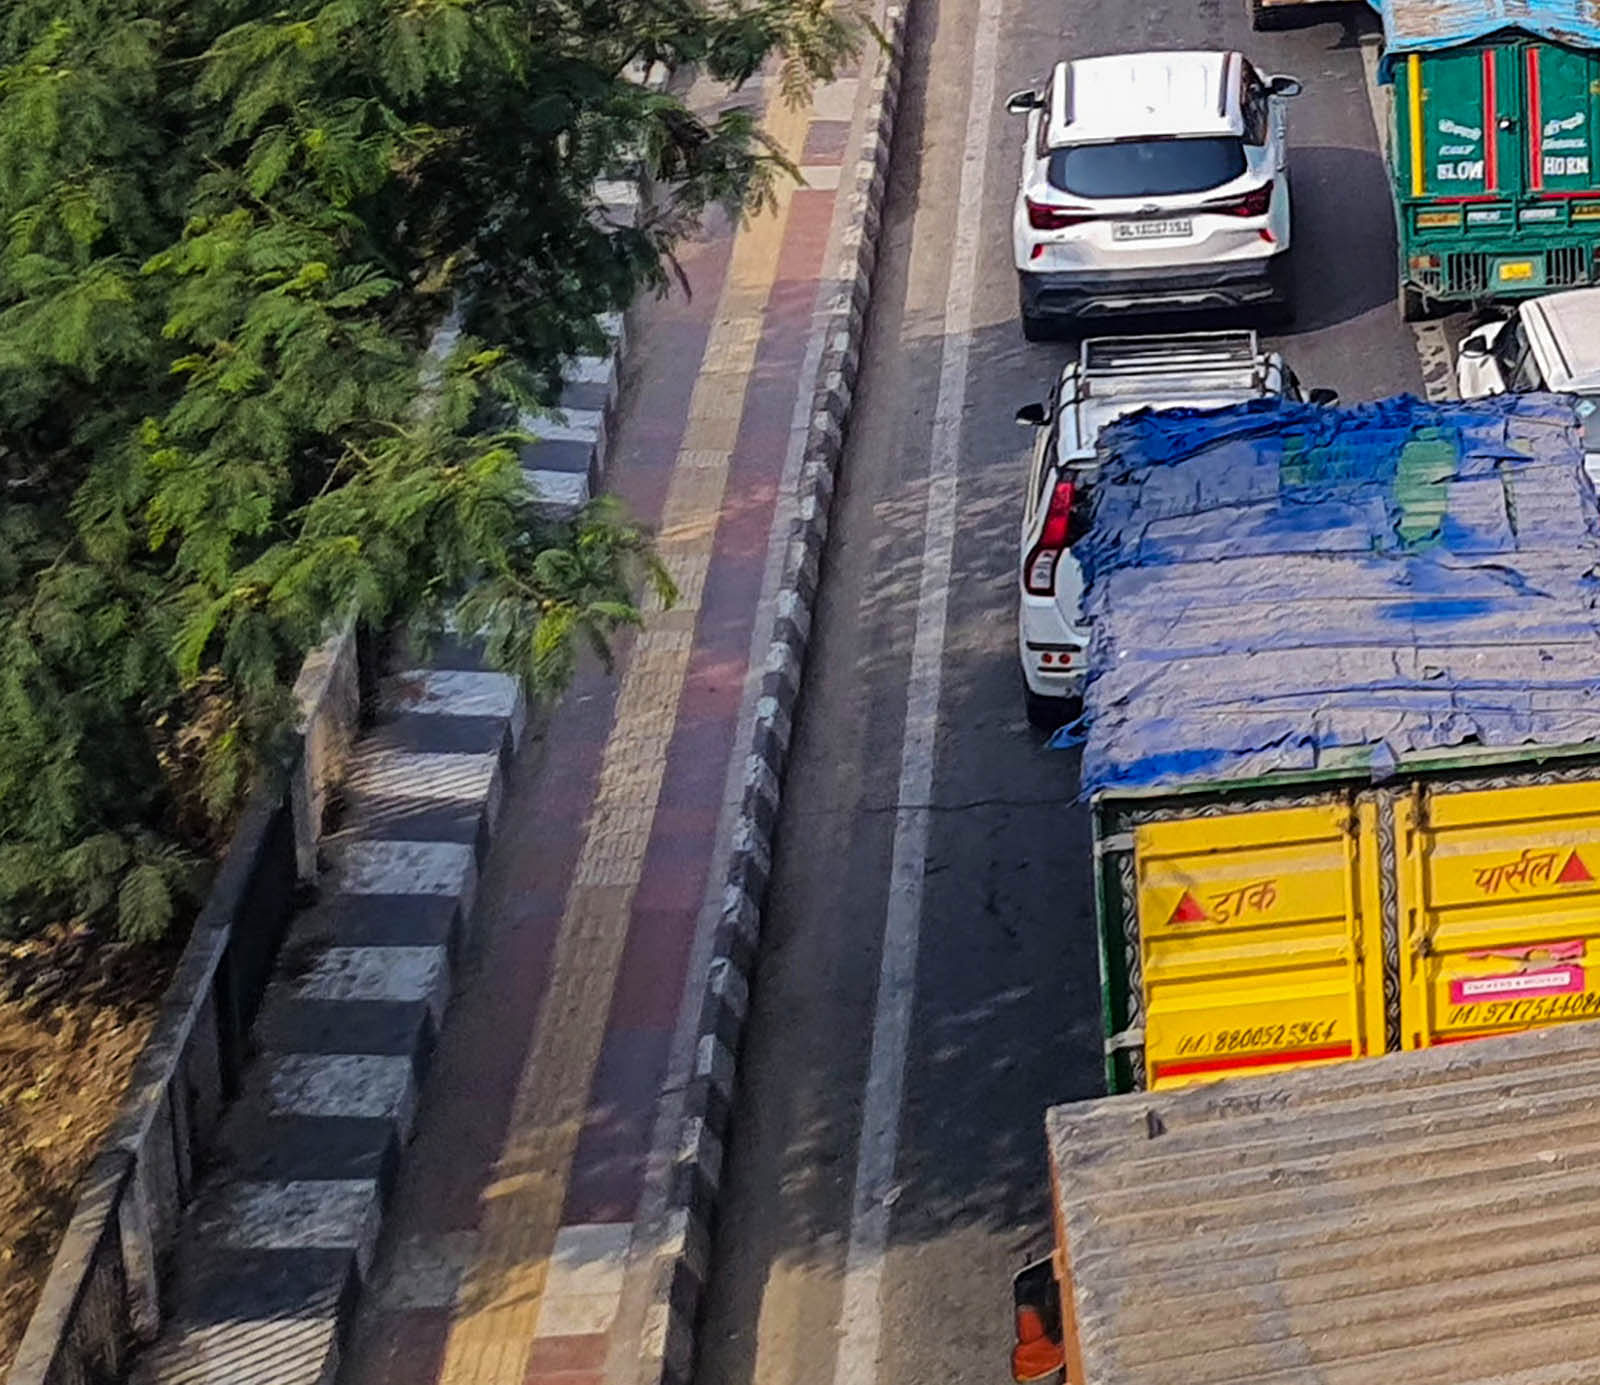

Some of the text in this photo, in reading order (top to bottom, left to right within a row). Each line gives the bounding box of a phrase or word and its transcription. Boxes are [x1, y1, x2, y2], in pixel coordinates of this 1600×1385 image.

[1543, 156, 1589, 176] HORN
[1473, 848, 1560, 894] पार्सल
[1208, 879, 1277, 925] डाक
